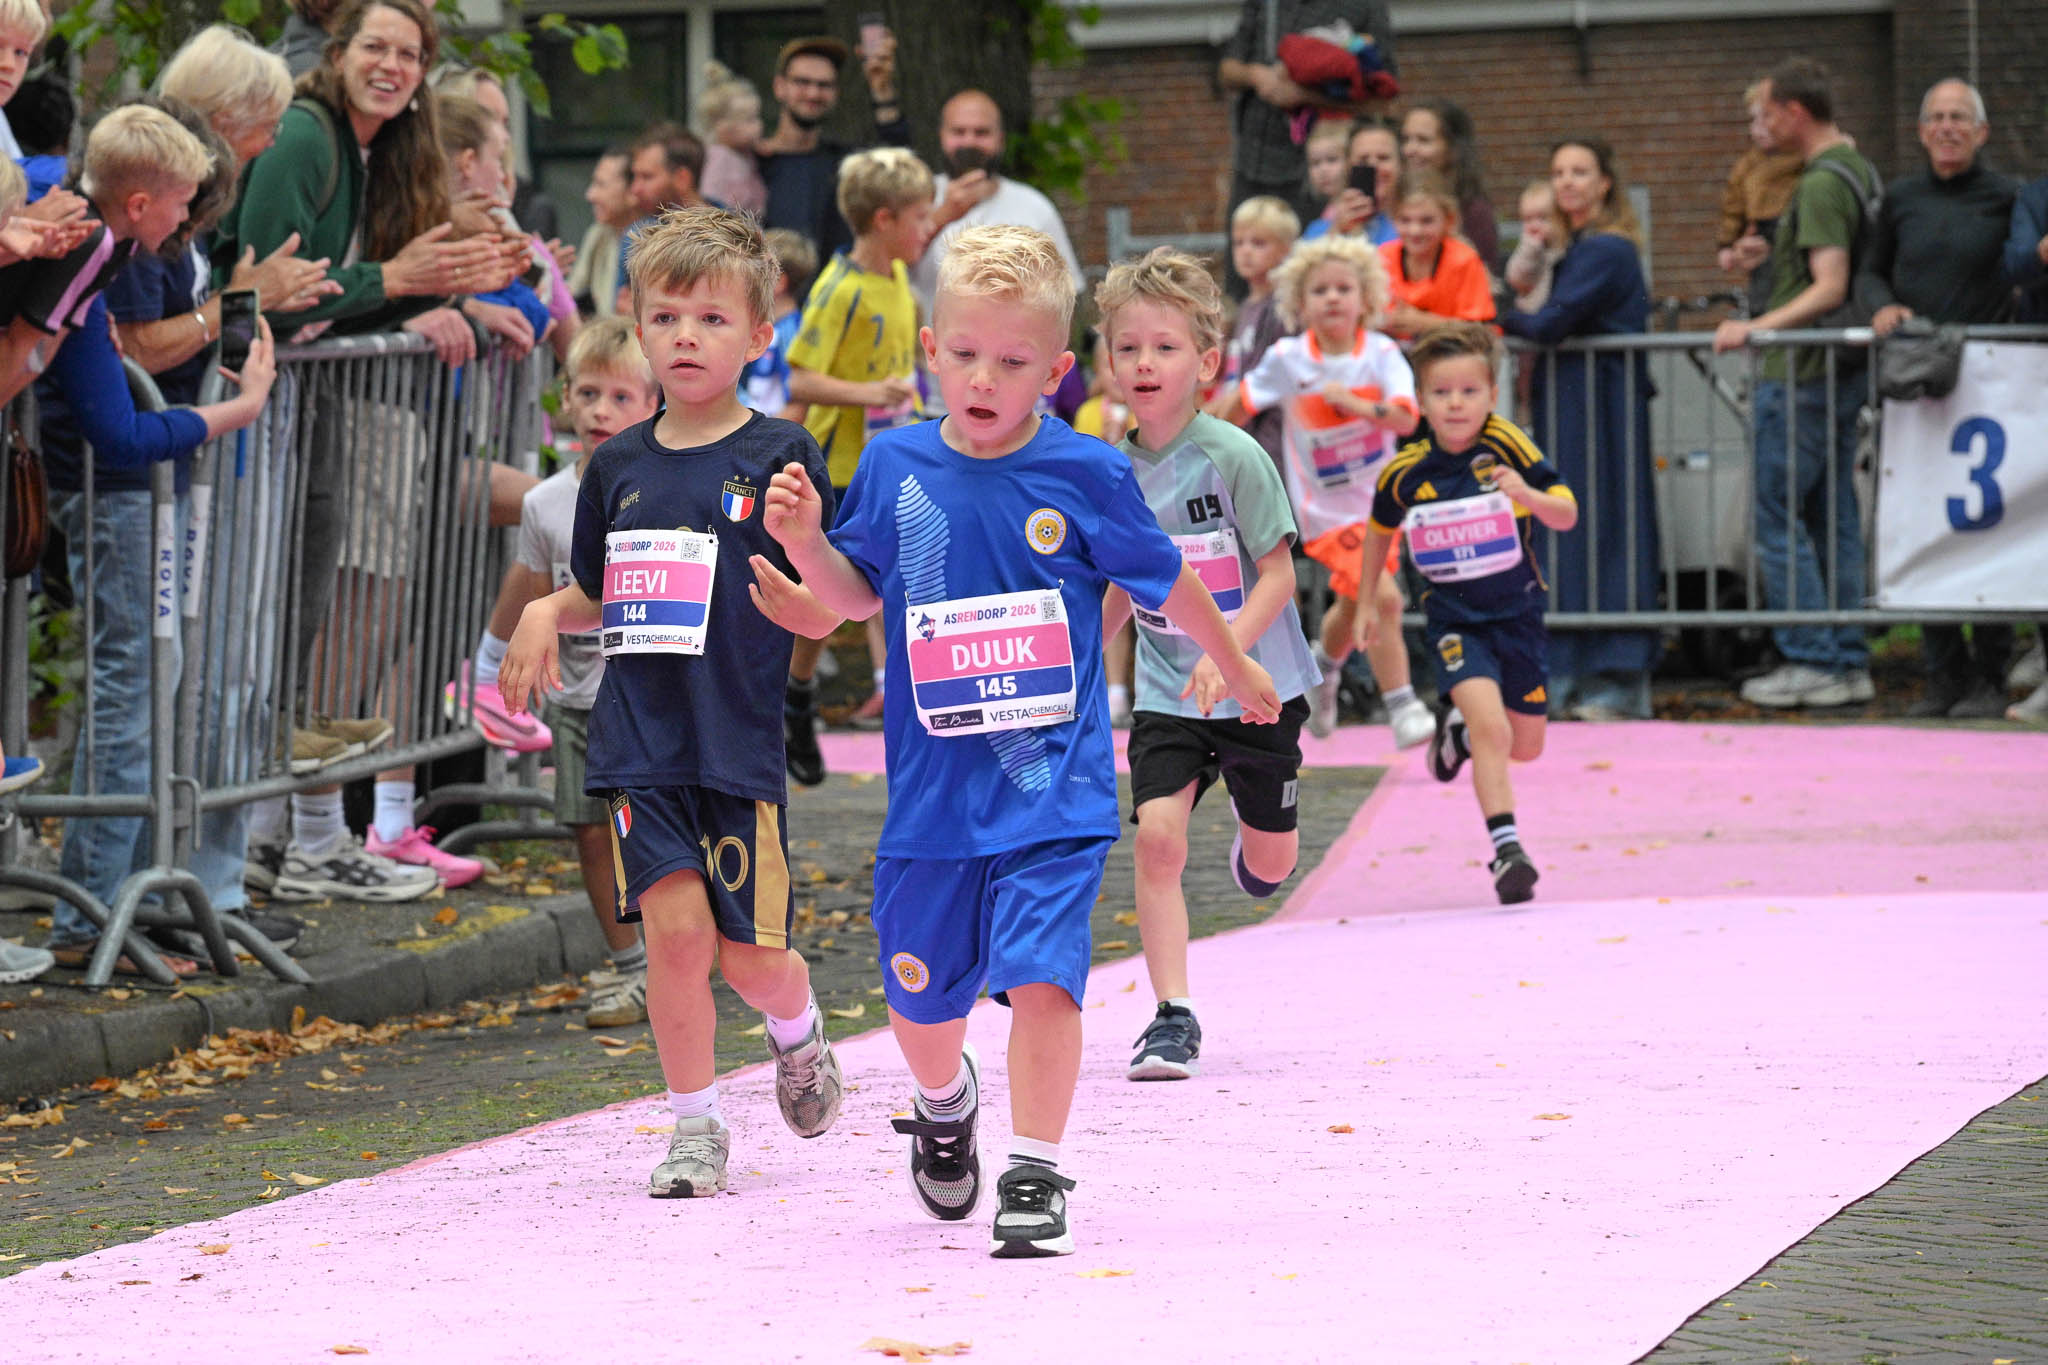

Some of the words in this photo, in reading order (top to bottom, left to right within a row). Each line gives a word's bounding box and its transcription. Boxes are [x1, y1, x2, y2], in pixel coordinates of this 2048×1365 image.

[1946, 414, 2007, 532] 3
[726, 484, 753, 496] FRANCE
[1424, 519, 1497, 547] OLIVIER
[614, 541, 652, 553] ASRENDORP
[653, 541, 676, 552] 2026
[1185, 545, 1206, 554] 2026
[159, 549, 173, 617] ROVA
[613, 569, 668, 596] LEEVI
[622, 603, 647, 622] 144
[944, 607, 1007, 625] ASRENDORP
[1010, 604, 1037, 618] 2026
[951, 635, 1038, 671] DUUK
[975, 675, 1017, 698] 145
